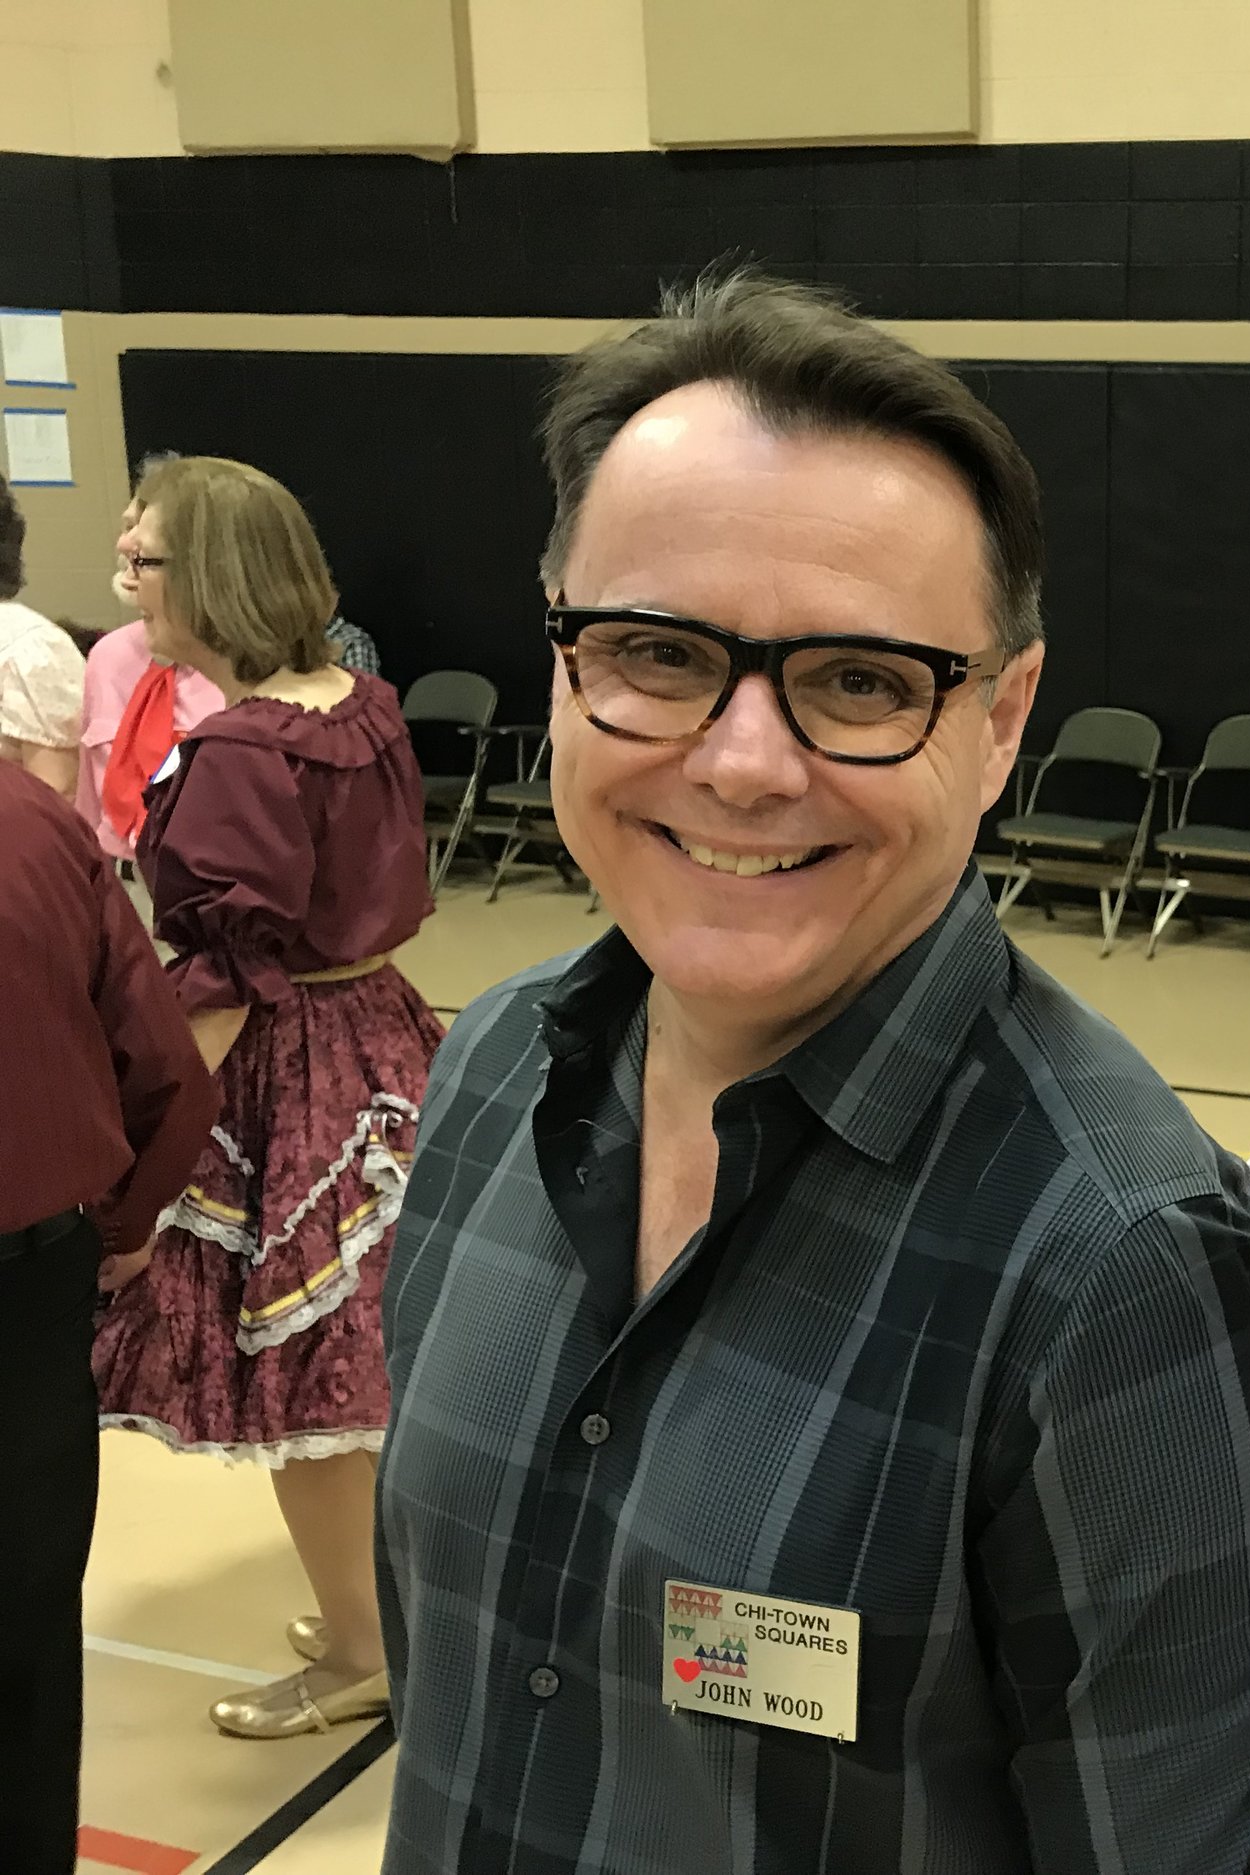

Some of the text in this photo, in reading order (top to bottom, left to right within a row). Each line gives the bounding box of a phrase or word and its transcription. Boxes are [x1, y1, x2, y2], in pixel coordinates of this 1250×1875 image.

[735, 1602, 830, 1632] CHI-TOWN
[755, 1625, 848, 1655] SQUARES
[695, 1680, 823, 1721] JOHN WOOD
